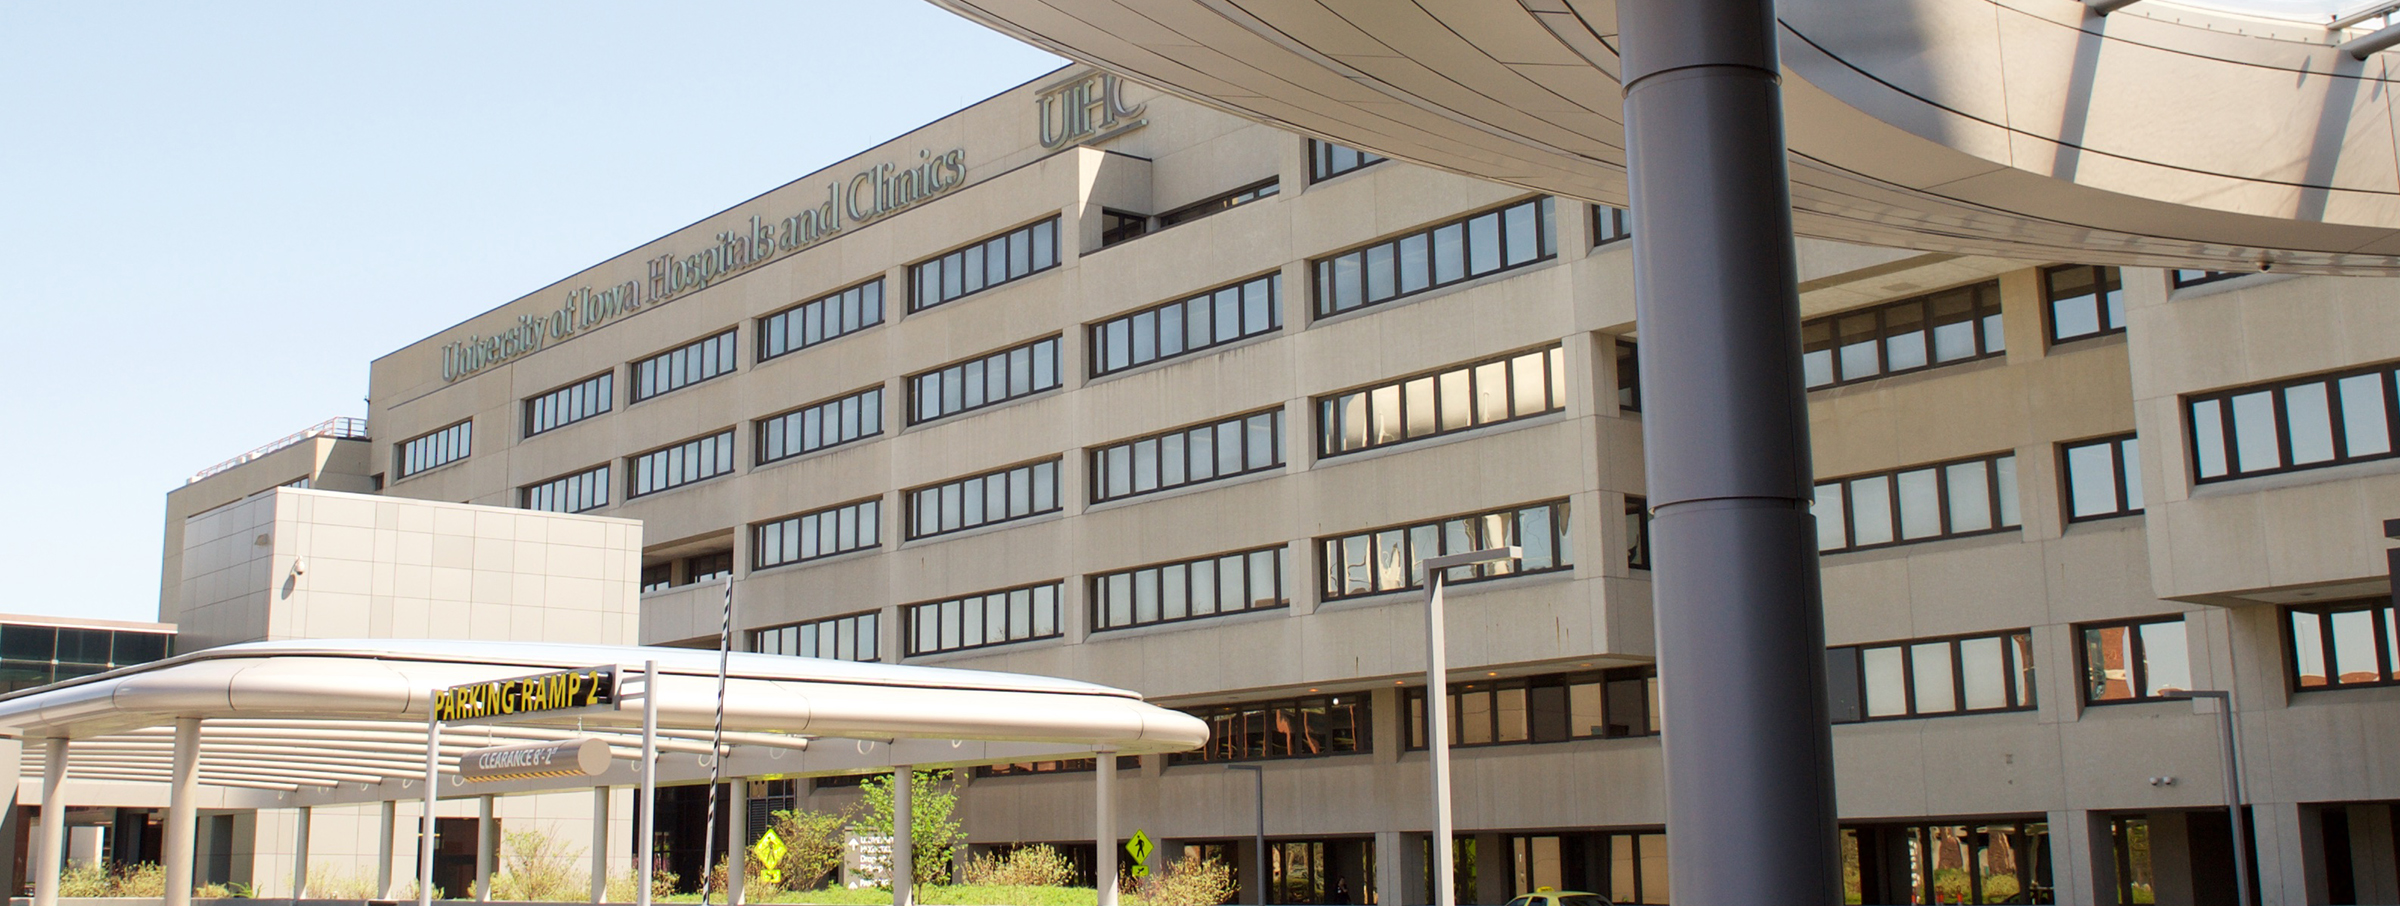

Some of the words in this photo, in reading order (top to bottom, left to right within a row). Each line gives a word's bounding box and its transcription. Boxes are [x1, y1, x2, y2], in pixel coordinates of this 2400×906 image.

[1035, 73, 1147, 149] UIHC
[441, 313, 549, 382] University
[550, 289, 578, 340] of
[578, 285, 641, 330] Iowa
[645, 214, 775, 303] Hospitals
[778, 181, 842, 252] and
[846, 147, 967, 222] Clinics
[434, 680, 516, 721] PARKING
[521, 671, 582, 712] RAMP
[586, 670, 598, 705] 2
[478, 748, 534, 769] CLEARANCE
